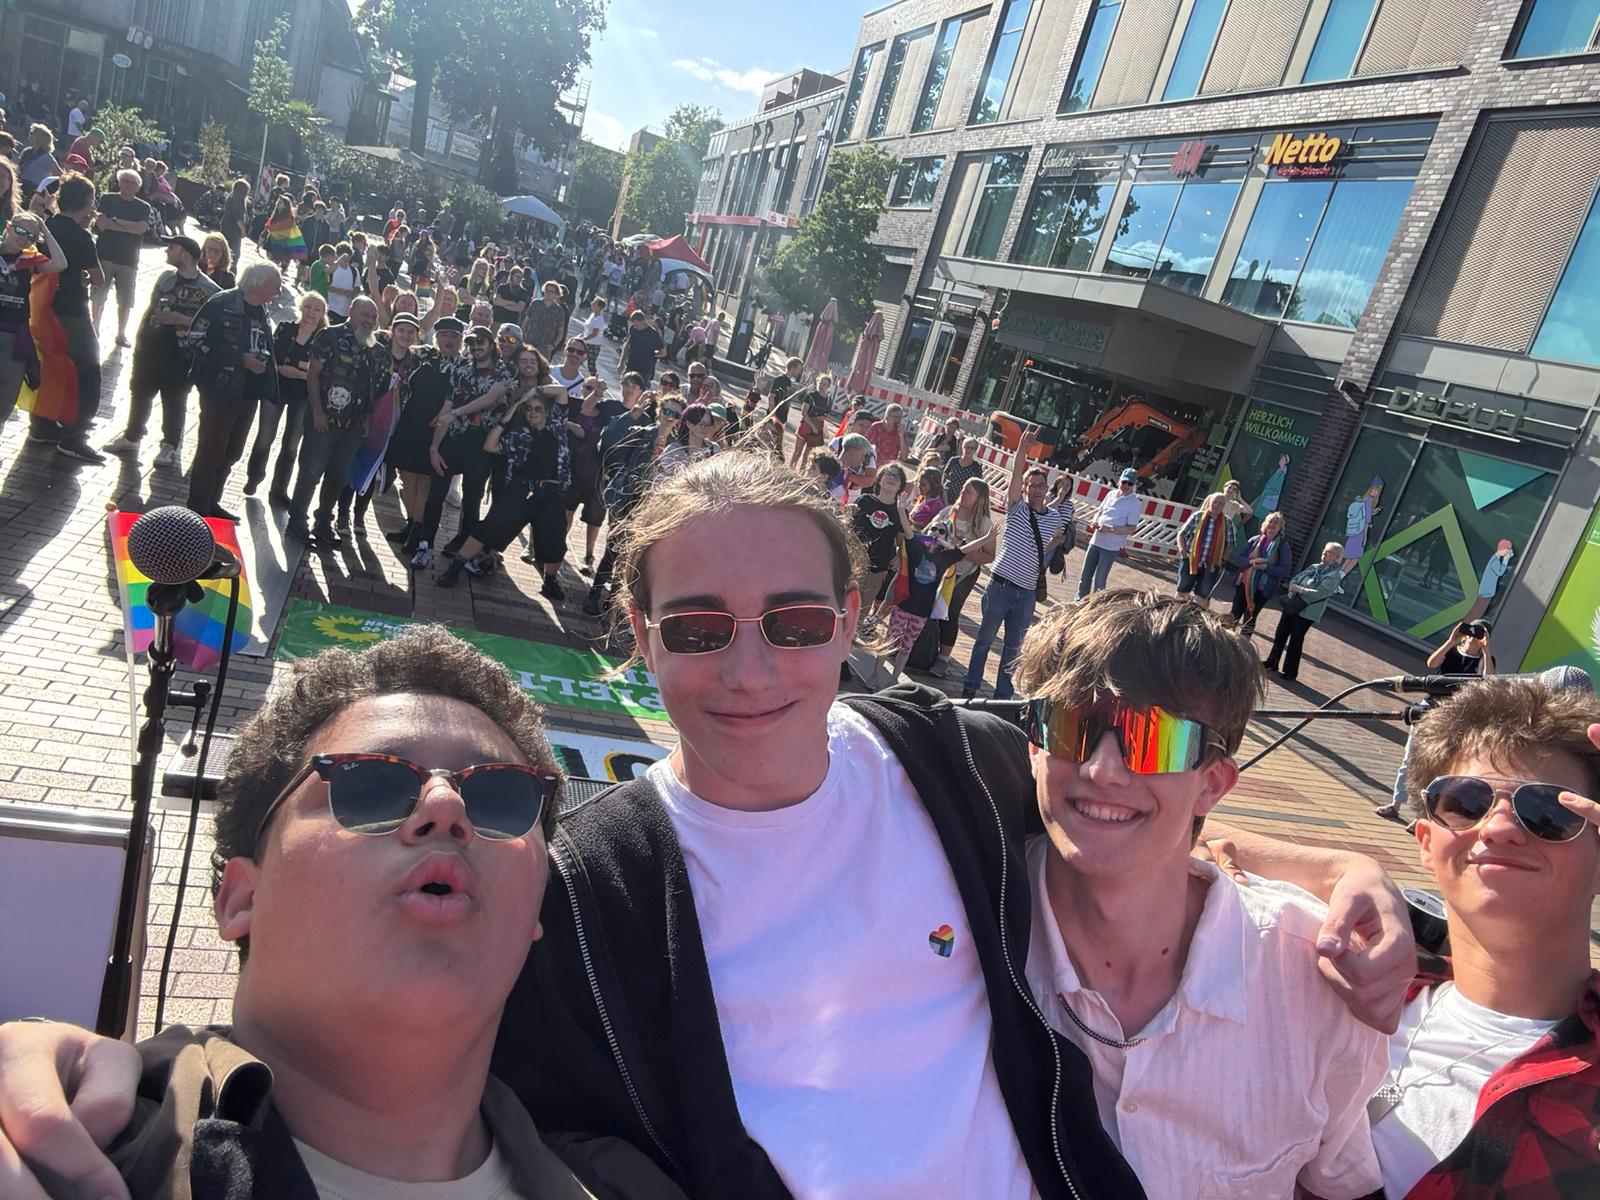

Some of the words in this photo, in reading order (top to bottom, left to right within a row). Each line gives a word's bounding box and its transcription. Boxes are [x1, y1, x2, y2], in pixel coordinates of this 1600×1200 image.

[1264, 132, 1341, 165] Netto
[1249, 408, 1295, 430] HERZLICH
[1386, 385, 1529, 436] DEPOT
[1244, 421, 1310, 449] WILLKOMMEN
